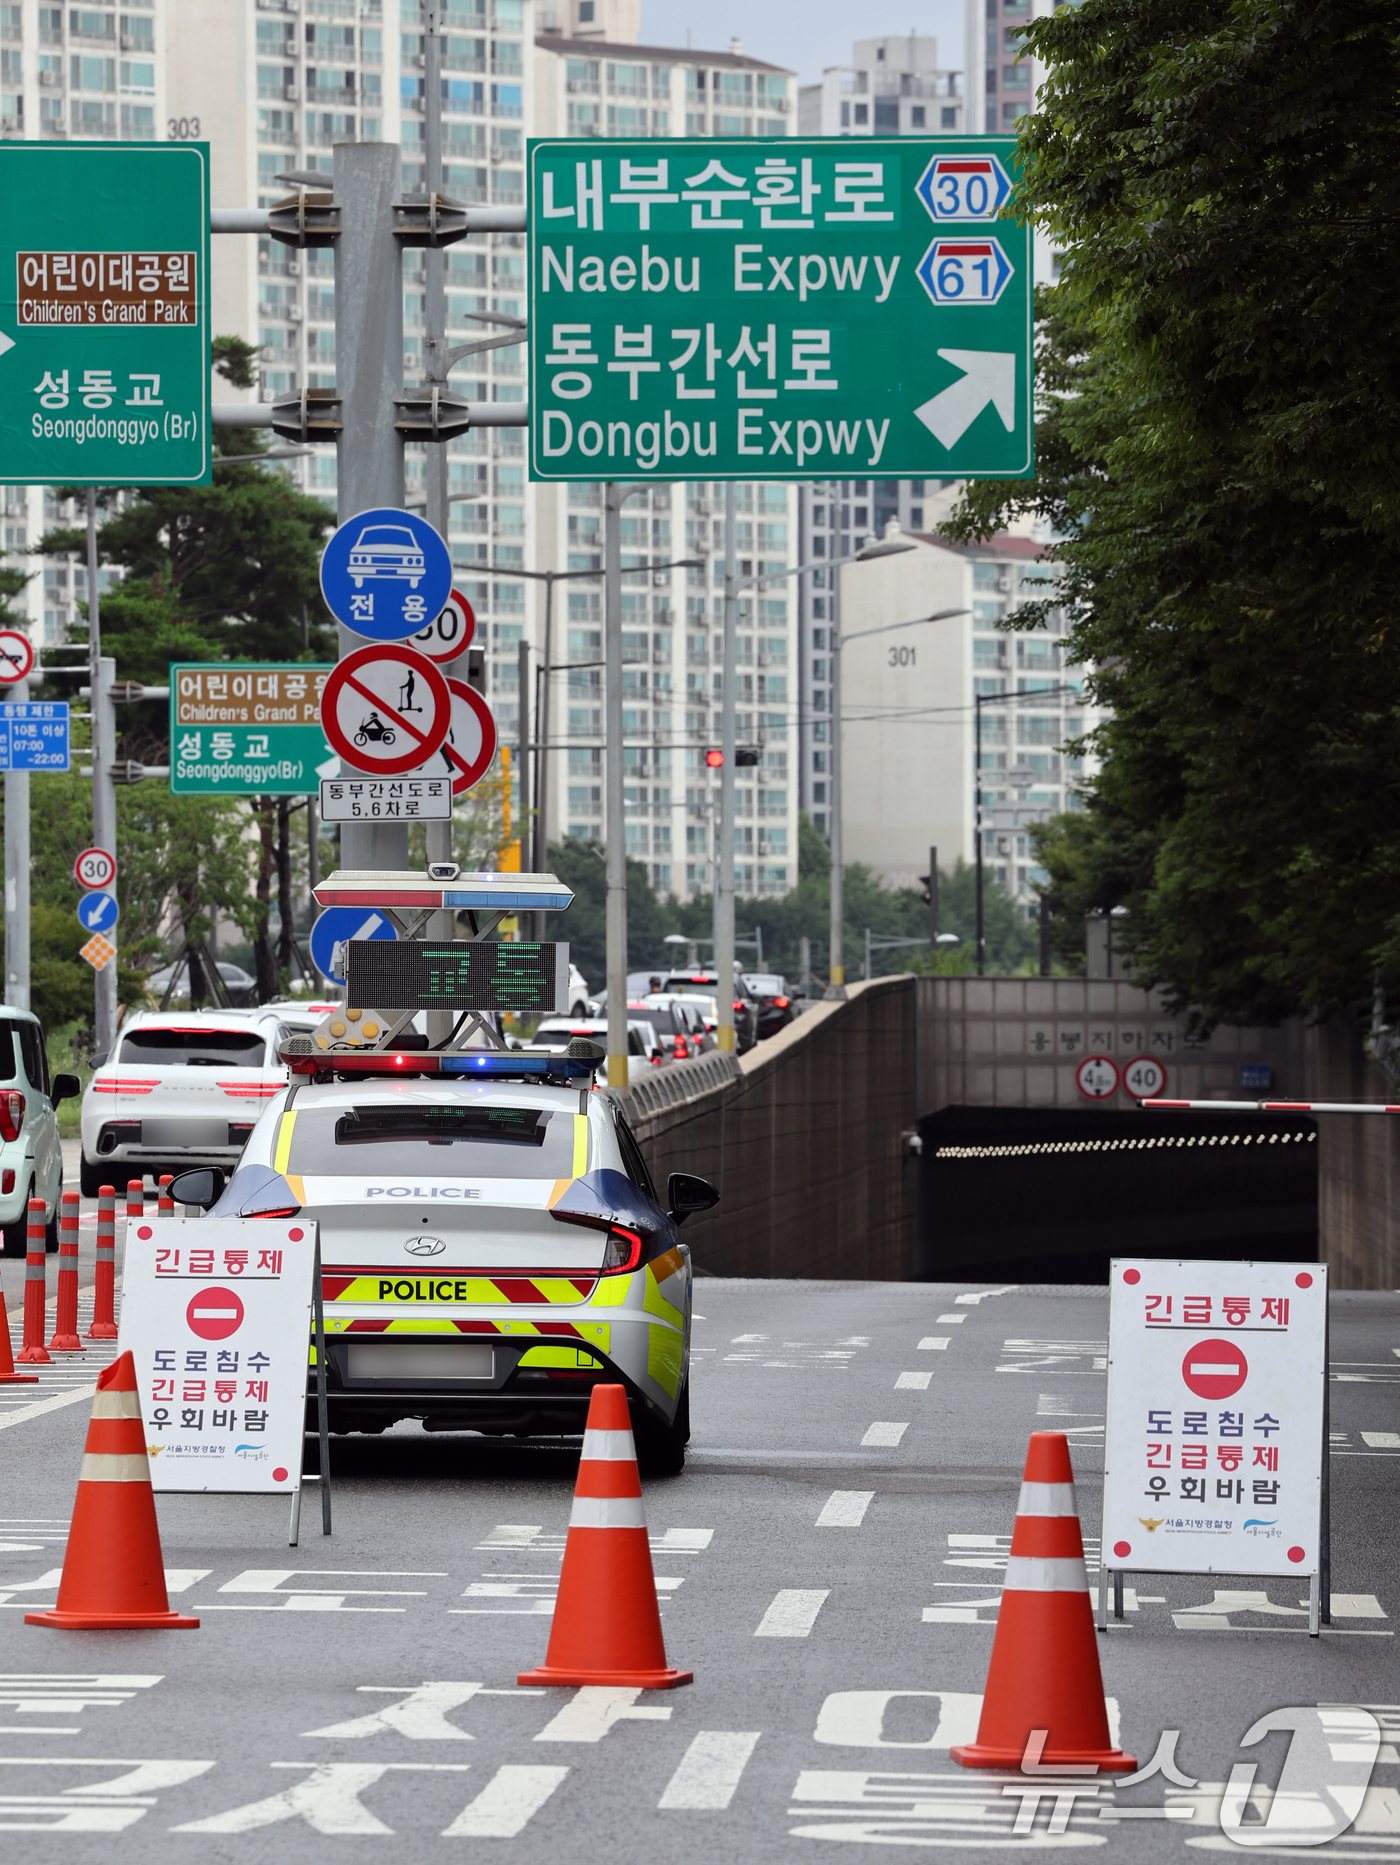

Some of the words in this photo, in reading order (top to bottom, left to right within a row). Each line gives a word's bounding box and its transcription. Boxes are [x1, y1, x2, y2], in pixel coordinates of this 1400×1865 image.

[167, 116, 201, 140] 303
[542, 158, 894, 231] 내부순환로
[936, 175, 989, 215] 30
[23, 254, 190, 292] 어린이대공원
[541, 244, 700, 293] Naebu
[734, 243, 901, 303] Expwy
[938, 257, 993, 298] 61
[22, 299, 96, 323] Children's
[102, 299, 146, 323] Grand
[154, 299, 189, 323] Park
[545, 323, 839, 401] 동부간선로
[34, 369, 164, 409] 성동교
[32, 414, 159, 444] Seongdonggyo
[164, 411, 197, 441] (Br)
[542, 409, 717, 469] Dongbu
[737, 408, 890, 466] Expwy
[888, 646, 917, 667] 301
[180, 703, 248, 721] Children's
[254, 703, 297, 721] Grand
[304, 703, 321, 721] Pa
[42, 724, 65, 737] 이상
[13, 740, 44, 752] 07:00
[177, 731, 270, 760] 성동교
[329, 782, 443, 800] 동부간선도로
[352, 801, 420, 817] 5,6차로
[84, 860, 108, 878] 30
[1131, 1068, 1157, 1087] 40
[366, 1186, 482, 1199] POLICE
[155, 1248, 283, 1276] 긴급통제
[379, 1281, 467, 1301] POLICE
[1144, 1296, 1290, 1326] 긴급통제
[153, 1349, 270, 1373] 도로침수
[151, 1378, 269, 1403] 긴급통제
[149, 1407, 269, 1432] 우회바람
[1146, 1410, 1280, 1439] 도로침수
[166, 1444, 226, 1454] 서울지방경찰청
[1146, 1443, 1279, 1472] 긴급통제
[1144, 1476, 1281, 1506] 우회바람
[1165, 1518, 1233, 1529] 서울지방경찰청
[1246, 1526, 1282, 1539] 서울시설공단
